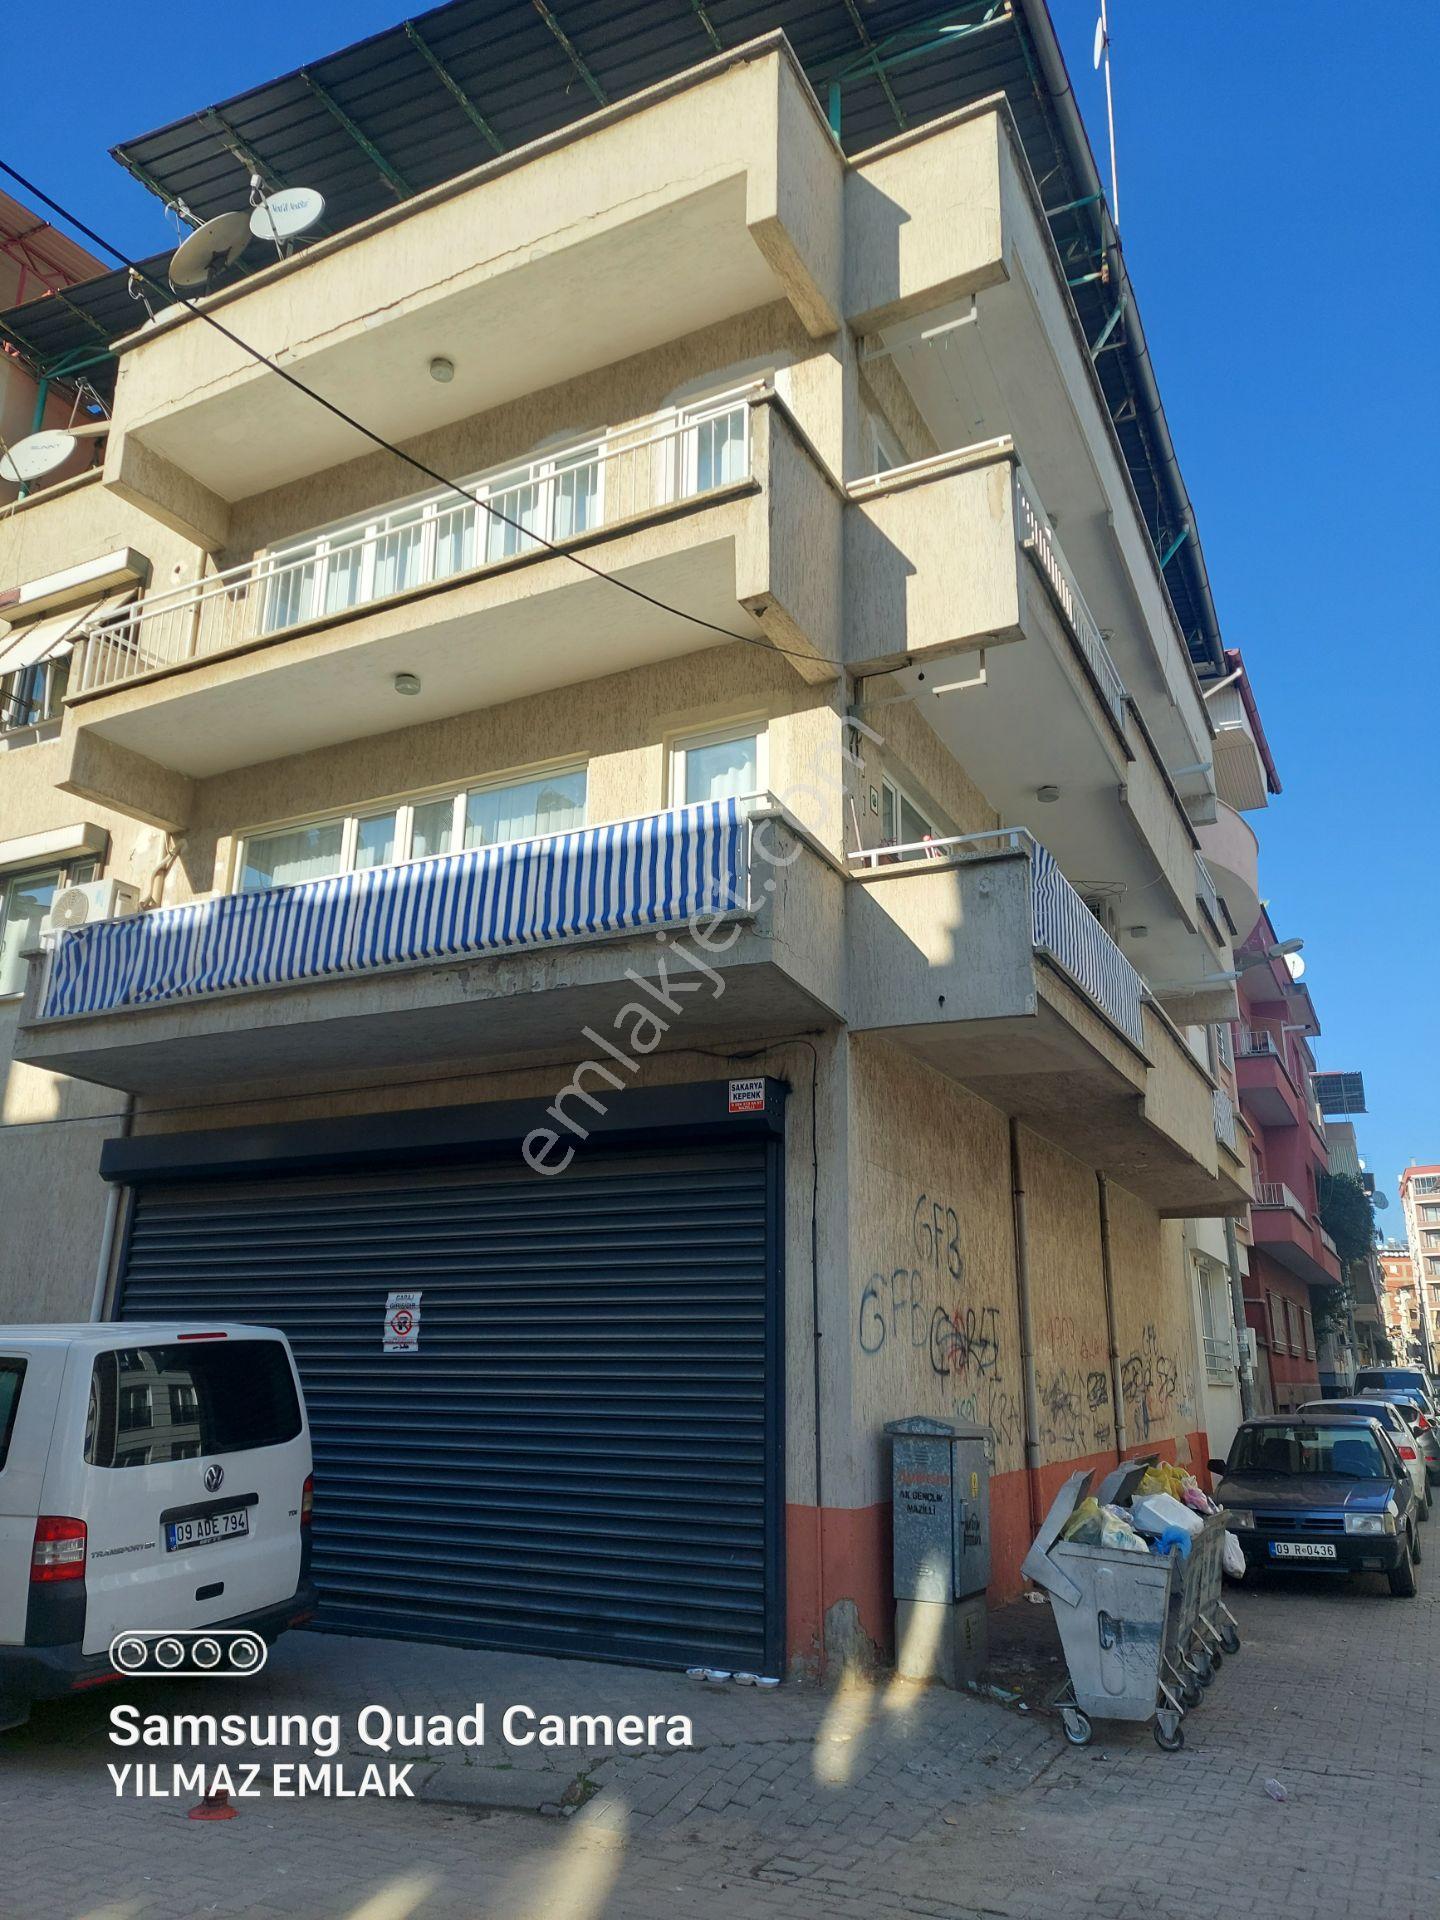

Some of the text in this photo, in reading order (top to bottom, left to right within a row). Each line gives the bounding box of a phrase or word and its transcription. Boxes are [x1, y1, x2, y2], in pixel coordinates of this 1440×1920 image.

[731, 1081, 763, 1092] SAKARYA
[733, 1091, 761, 1101] KEPENK
[914, 1193, 962, 1280] GFB
[859, 1268, 928, 1354] GFB
[176, 1525, 193, 1542] 09
[197, 1517, 220, 1537] ADE
[222, 1513, 246, 1532] 794
[91, 1541, 156, 1559] TRANSPORTER
[1276, 1544, 1334, 1556] 09 R 0436
